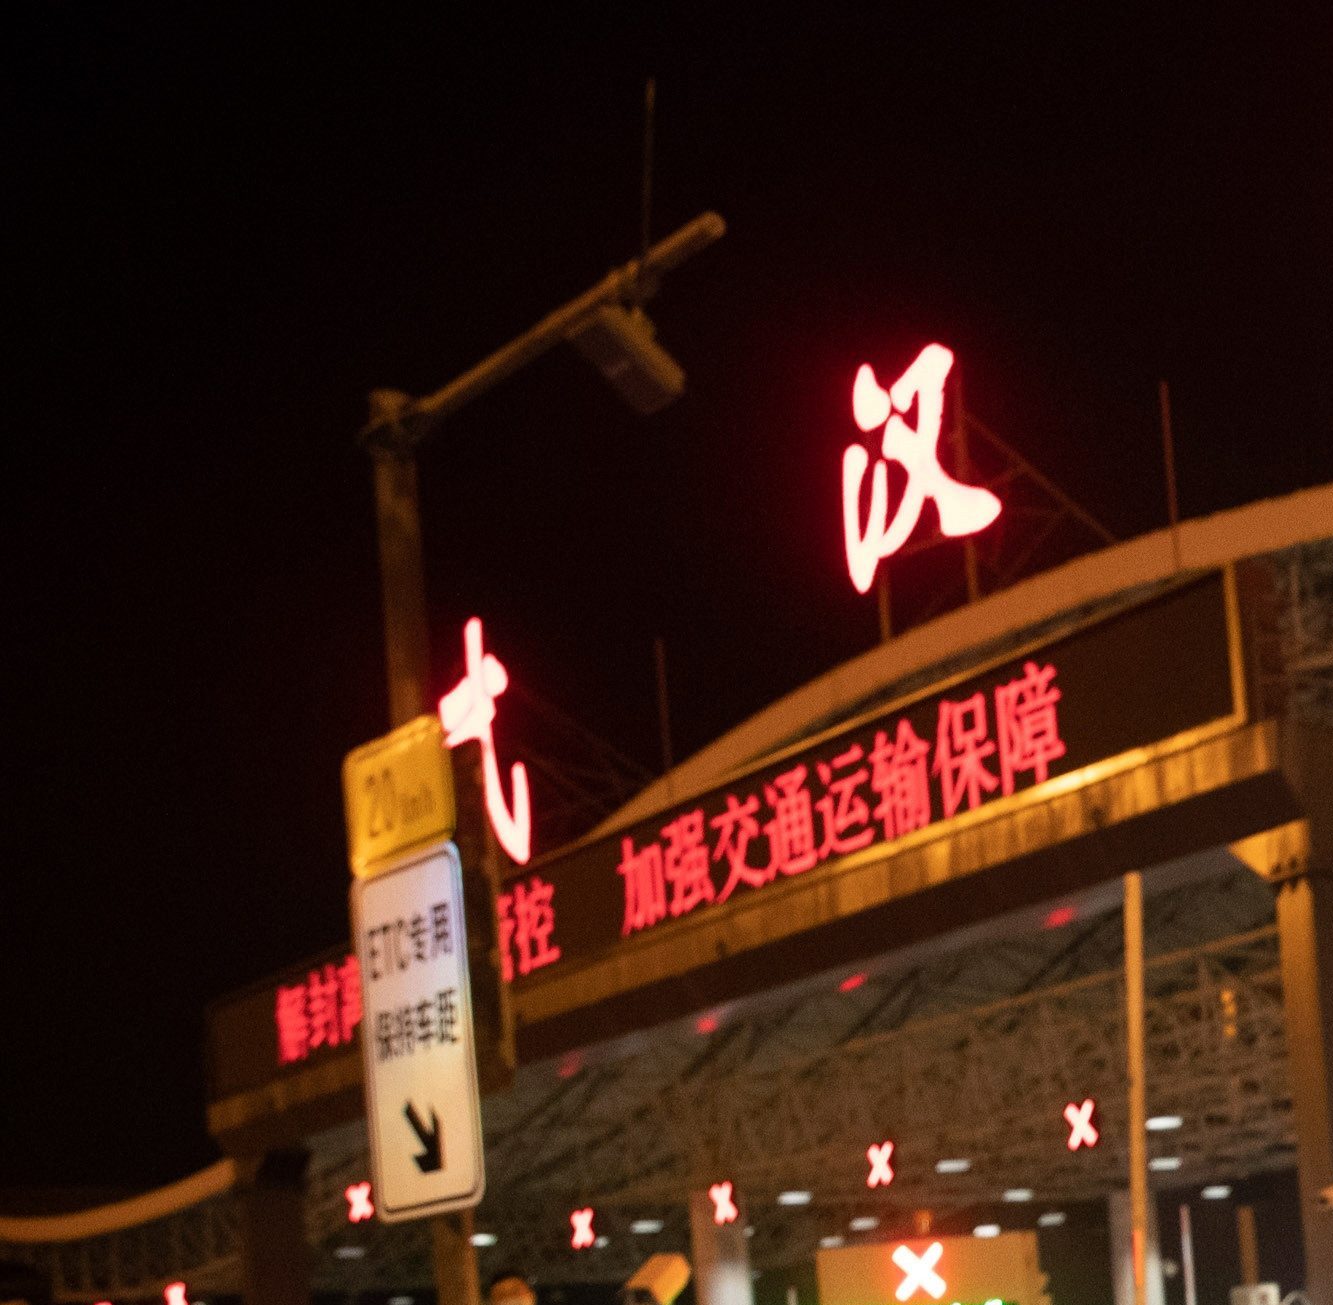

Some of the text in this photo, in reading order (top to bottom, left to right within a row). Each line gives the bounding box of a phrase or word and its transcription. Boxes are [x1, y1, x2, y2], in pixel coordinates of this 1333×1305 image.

[842, 342, 1002, 594] 汉
[616, 661, 1067, 938] 加强交通运输保障
